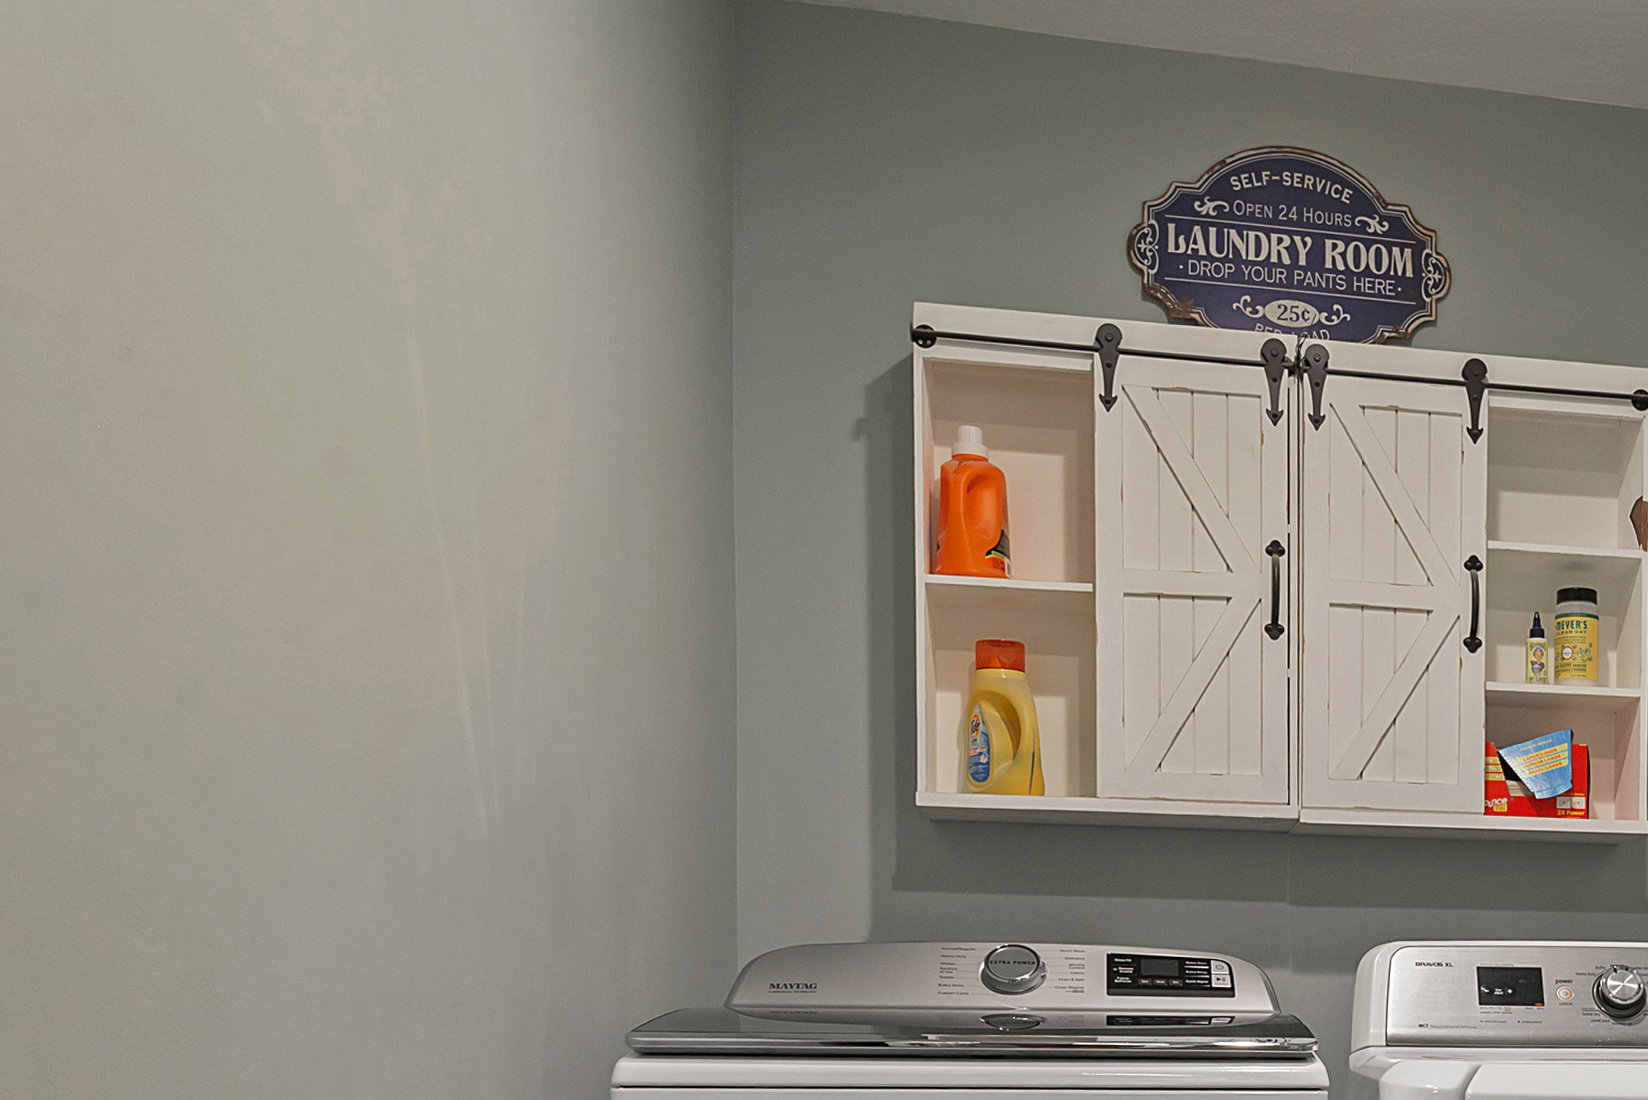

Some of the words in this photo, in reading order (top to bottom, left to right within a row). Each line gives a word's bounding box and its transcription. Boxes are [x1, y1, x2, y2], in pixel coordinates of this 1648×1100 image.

[1230, 170, 1354, 204] SELF-SERVICE
[1232, 200, 1273, 218] OPEN
[1278, 205, 1298, 221] 24
[1303, 210, 1353, 228] HOURS
[1167, 223, 1313, 266] LAUNDRY
[1324, 238, 1414, 278] ROOM
[1188, 260, 1236, 280] DROP
[1241, 264, 1287, 284] YOUR
[1294, 270, 1347, 290] PANTS
[1353, 276, 1396, 296] HERE
[1276, 303, 1310, 323] 25¢
[1484, 797, 1508, 808] ounce
[769, 982, 818, 990] MAYTAG
